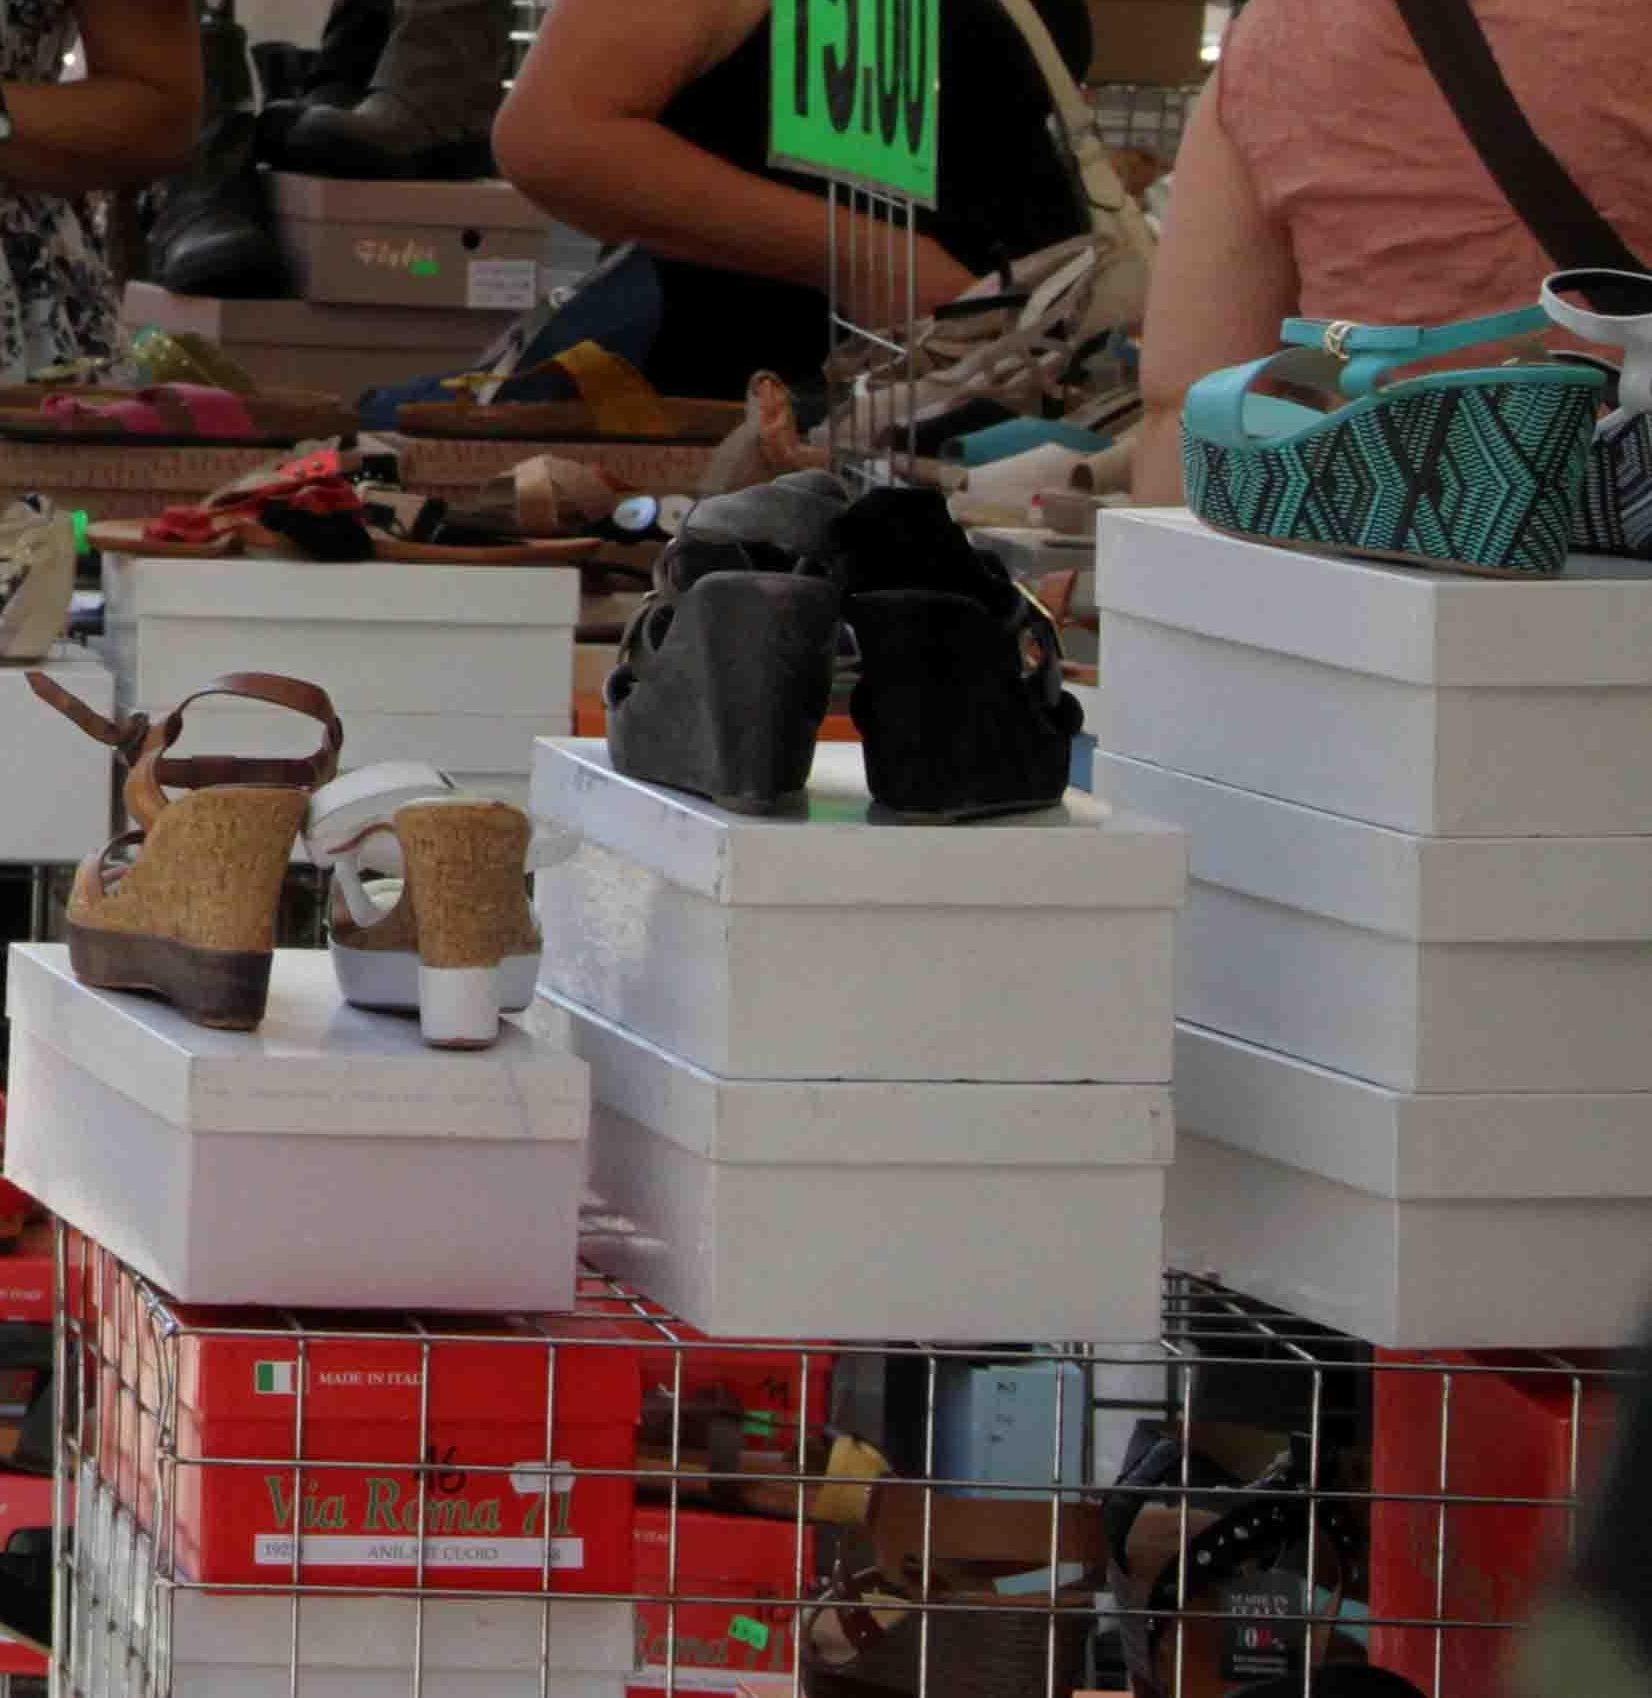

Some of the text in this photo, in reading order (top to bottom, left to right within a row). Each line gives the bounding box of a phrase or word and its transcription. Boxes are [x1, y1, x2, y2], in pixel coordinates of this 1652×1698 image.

[320, 1371, 430, 1386] MADE IN ITAL
[266, 1475, 346, 1531] Via
